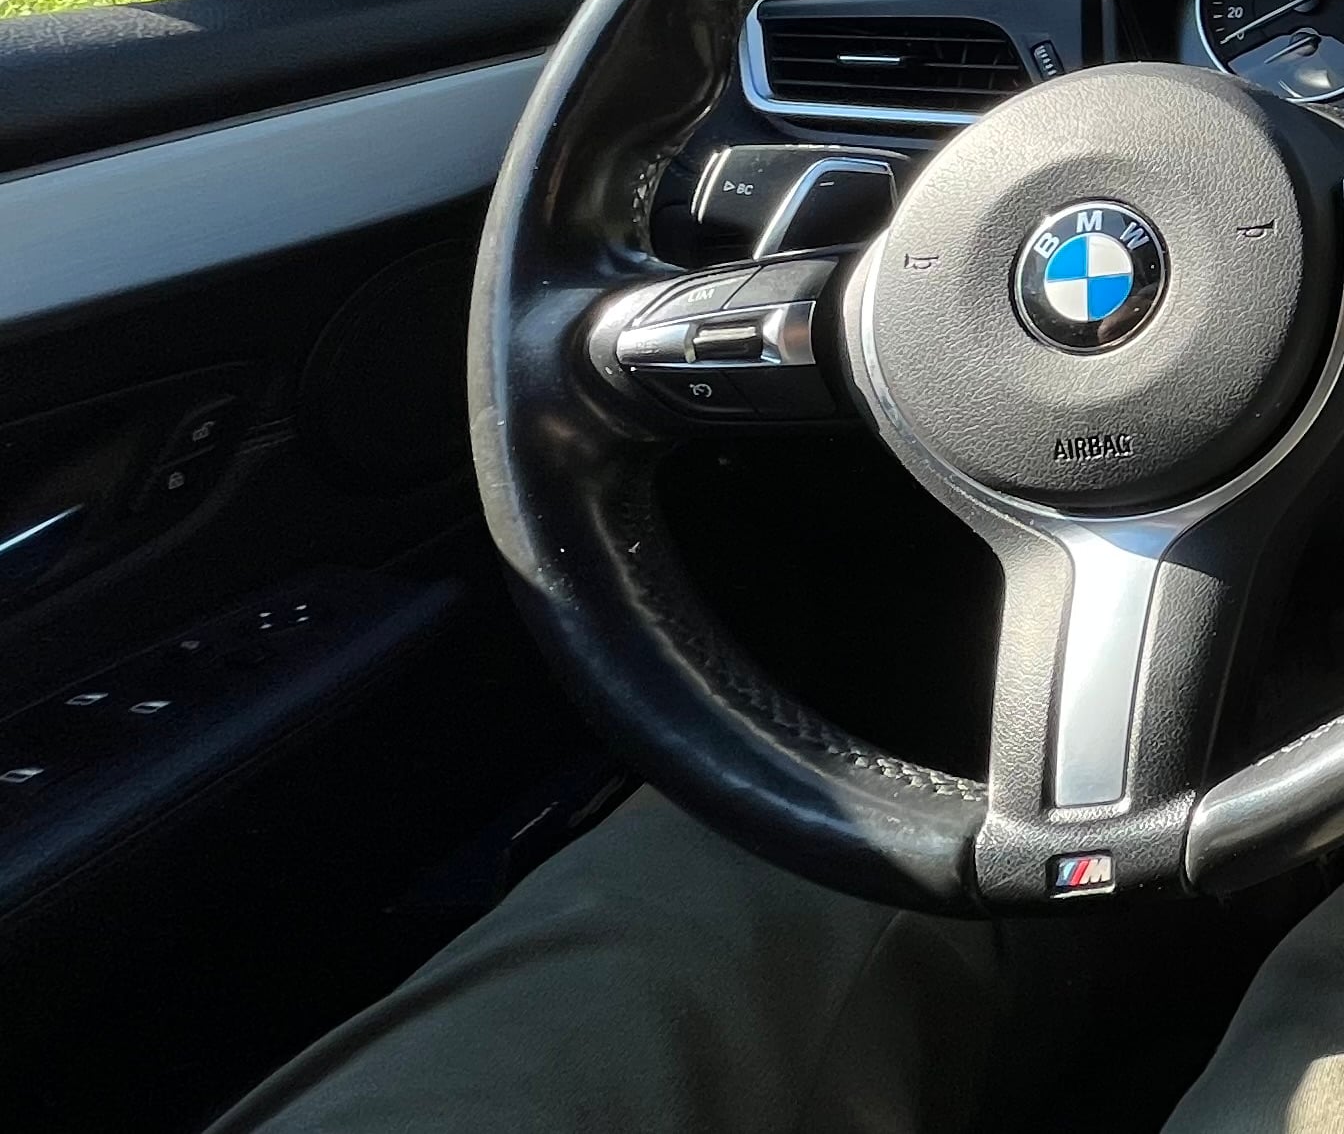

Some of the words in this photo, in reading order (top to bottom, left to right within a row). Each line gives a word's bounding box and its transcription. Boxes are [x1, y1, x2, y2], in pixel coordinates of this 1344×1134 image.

[1227, 6, 1243, 19] 20
[736, 182, 754, 195] BC
[1033, 209, 1150, 260] BMW
[687, 288, 715, 303] LIM
[1053, 433, 1134, 463] AIRBAG
